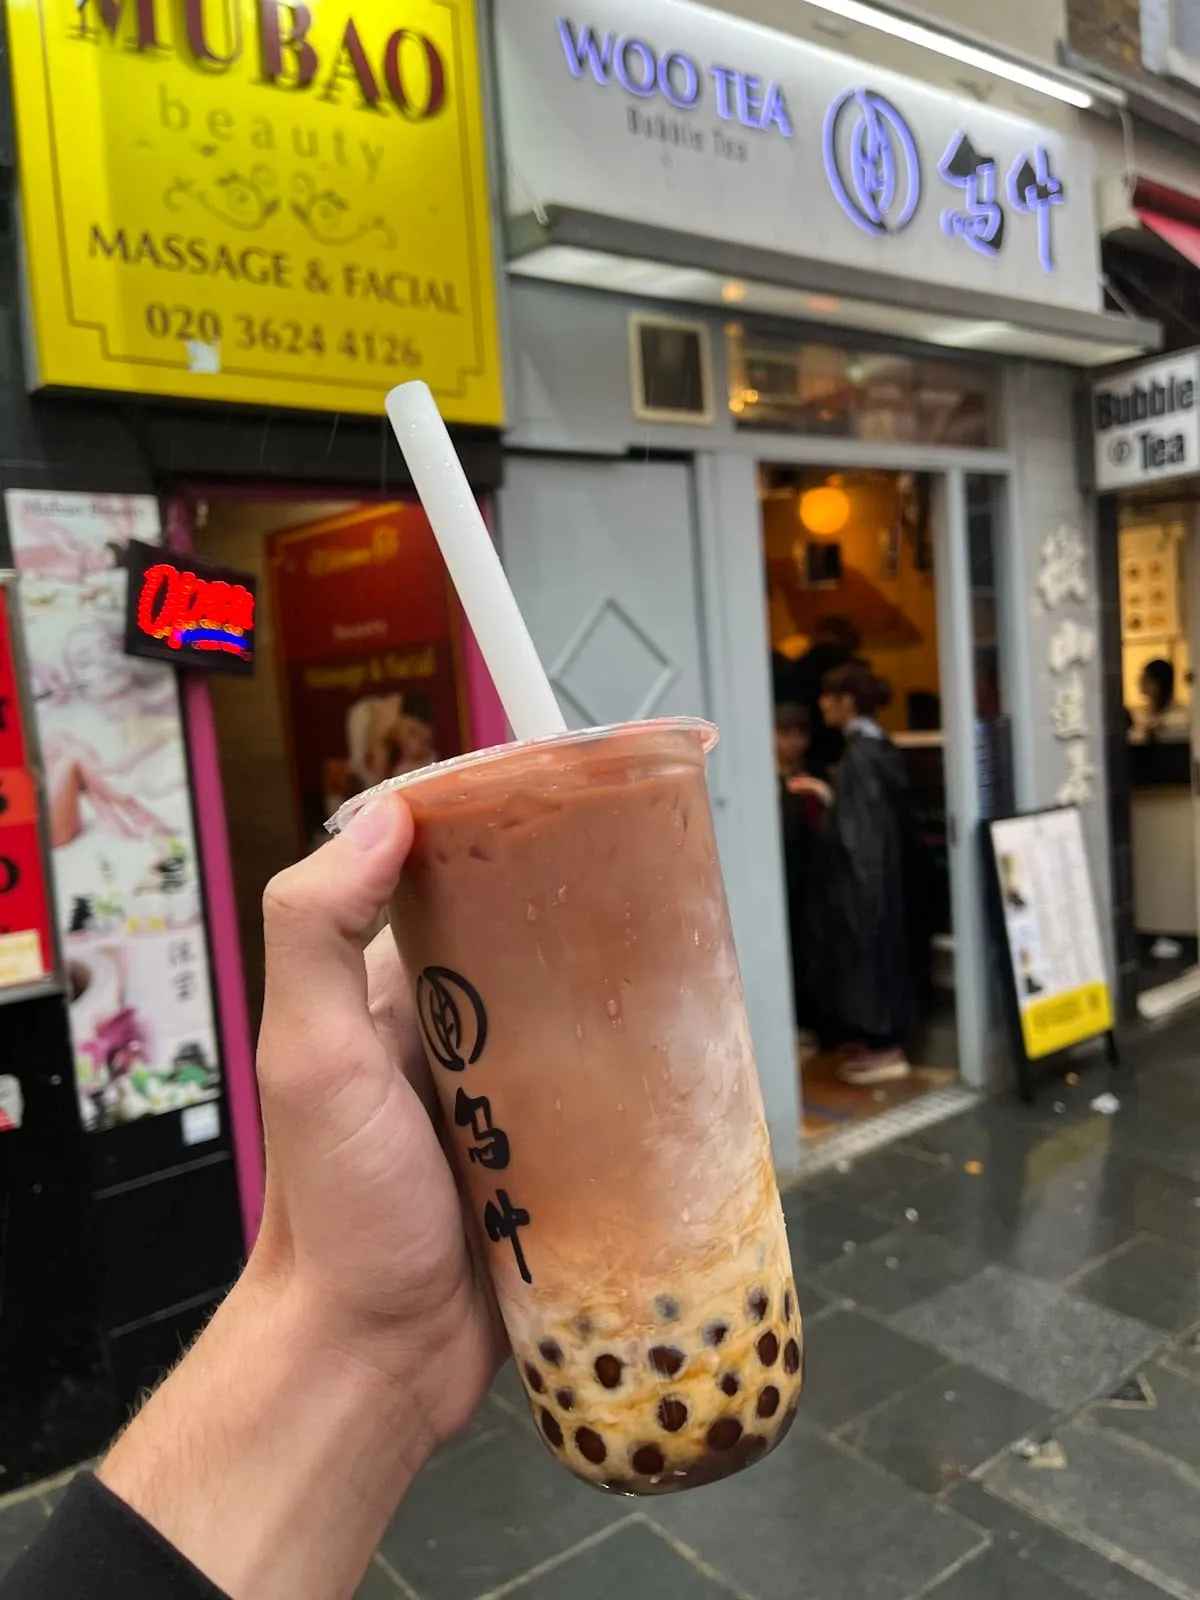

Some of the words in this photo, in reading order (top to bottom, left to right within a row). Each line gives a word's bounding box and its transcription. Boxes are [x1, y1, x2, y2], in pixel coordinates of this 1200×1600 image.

[556, 15, 699, 109] WOO
[709, 62, 794, 138] TEA
[158, 82, 386, 186] beauty
[626, 104, 705, 153] Bubble
[711, 129, 749, 163] Tea
[88, 224, 293, 289] MASSAGE
[304, 259, 332, 296] &
[343, 265, 464, 315] FACIAL
[145, 301, 222, 341] 020
[234, 314, 326, 356] 3624
[338, 330, 423, 369] 4126
[1096, 376, 1194, 431] Bubble
[1140, 433, 1184, 469] Tea
